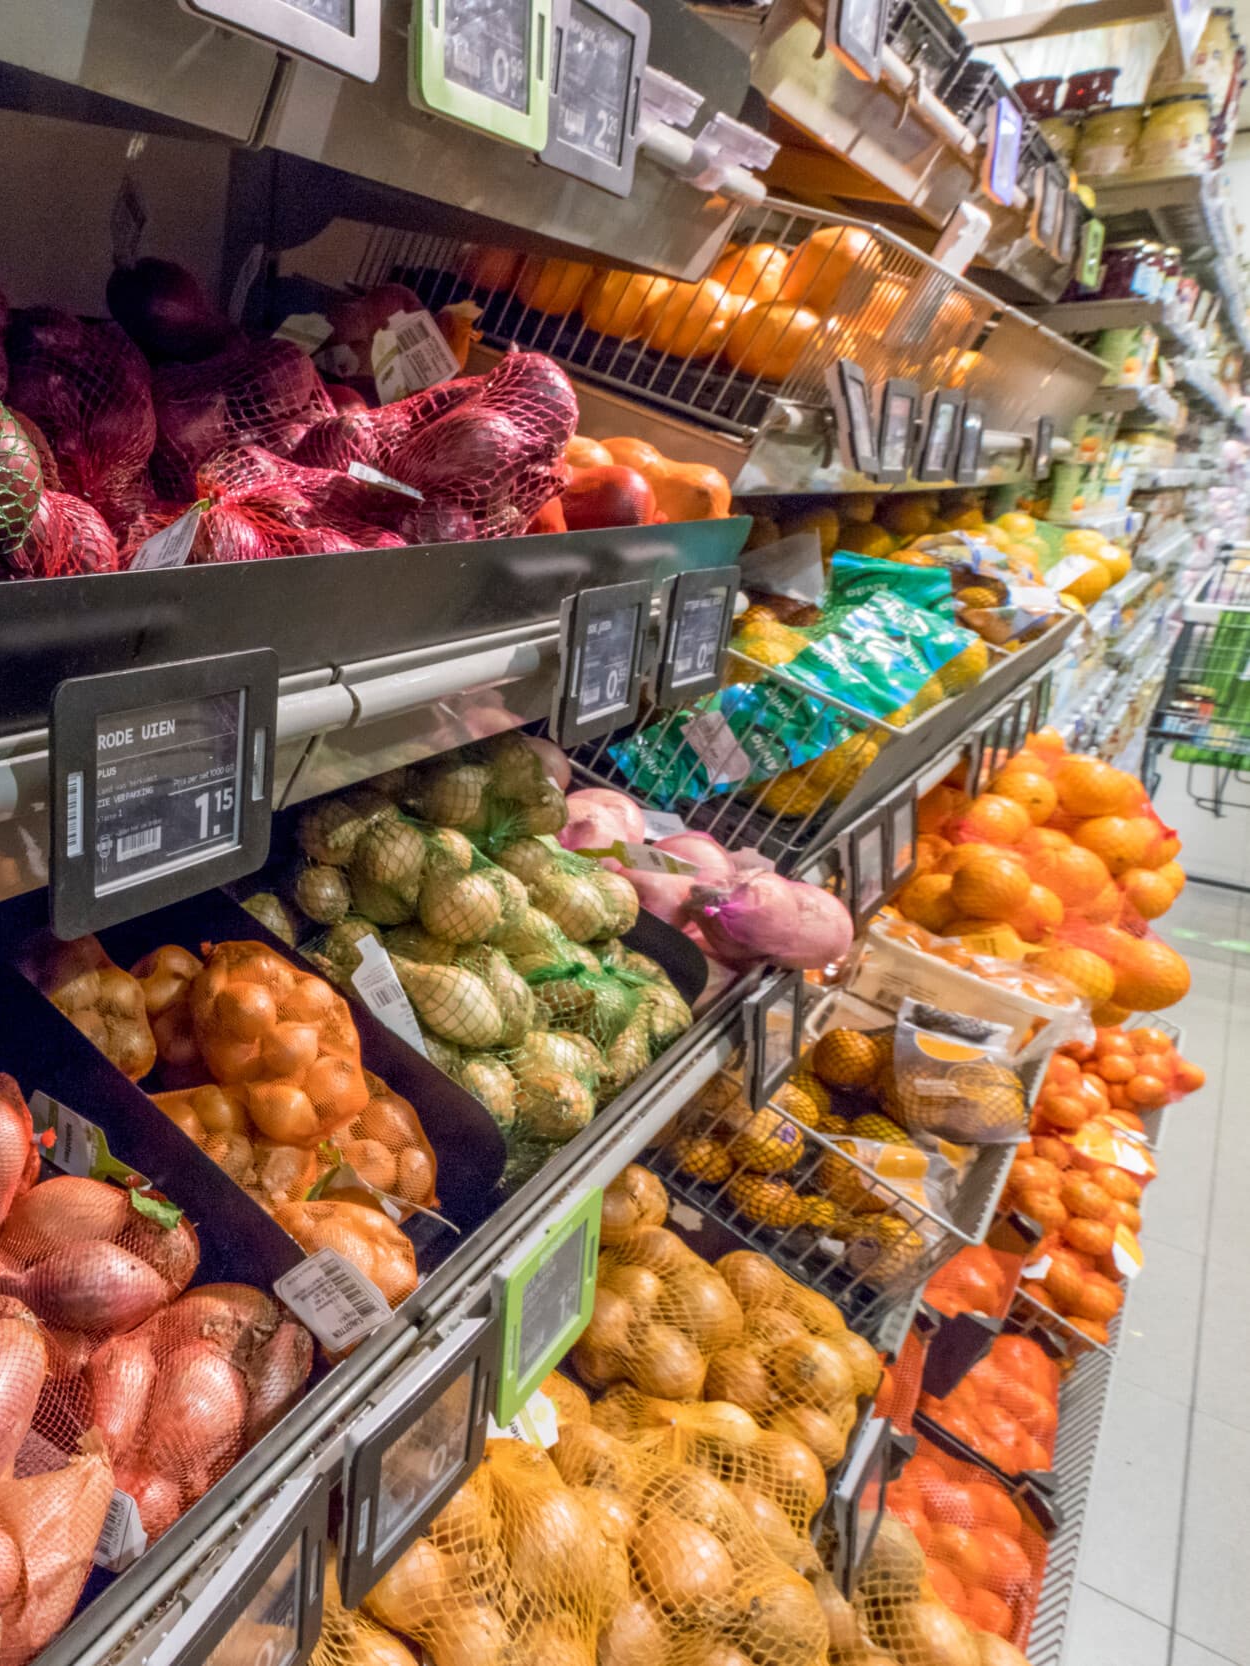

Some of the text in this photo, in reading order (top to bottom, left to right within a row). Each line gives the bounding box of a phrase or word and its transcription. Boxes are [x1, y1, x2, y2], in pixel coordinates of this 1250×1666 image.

[97, 719, 176, 751] RODE UIEN
[97, 767, 117, 780] PLUS
